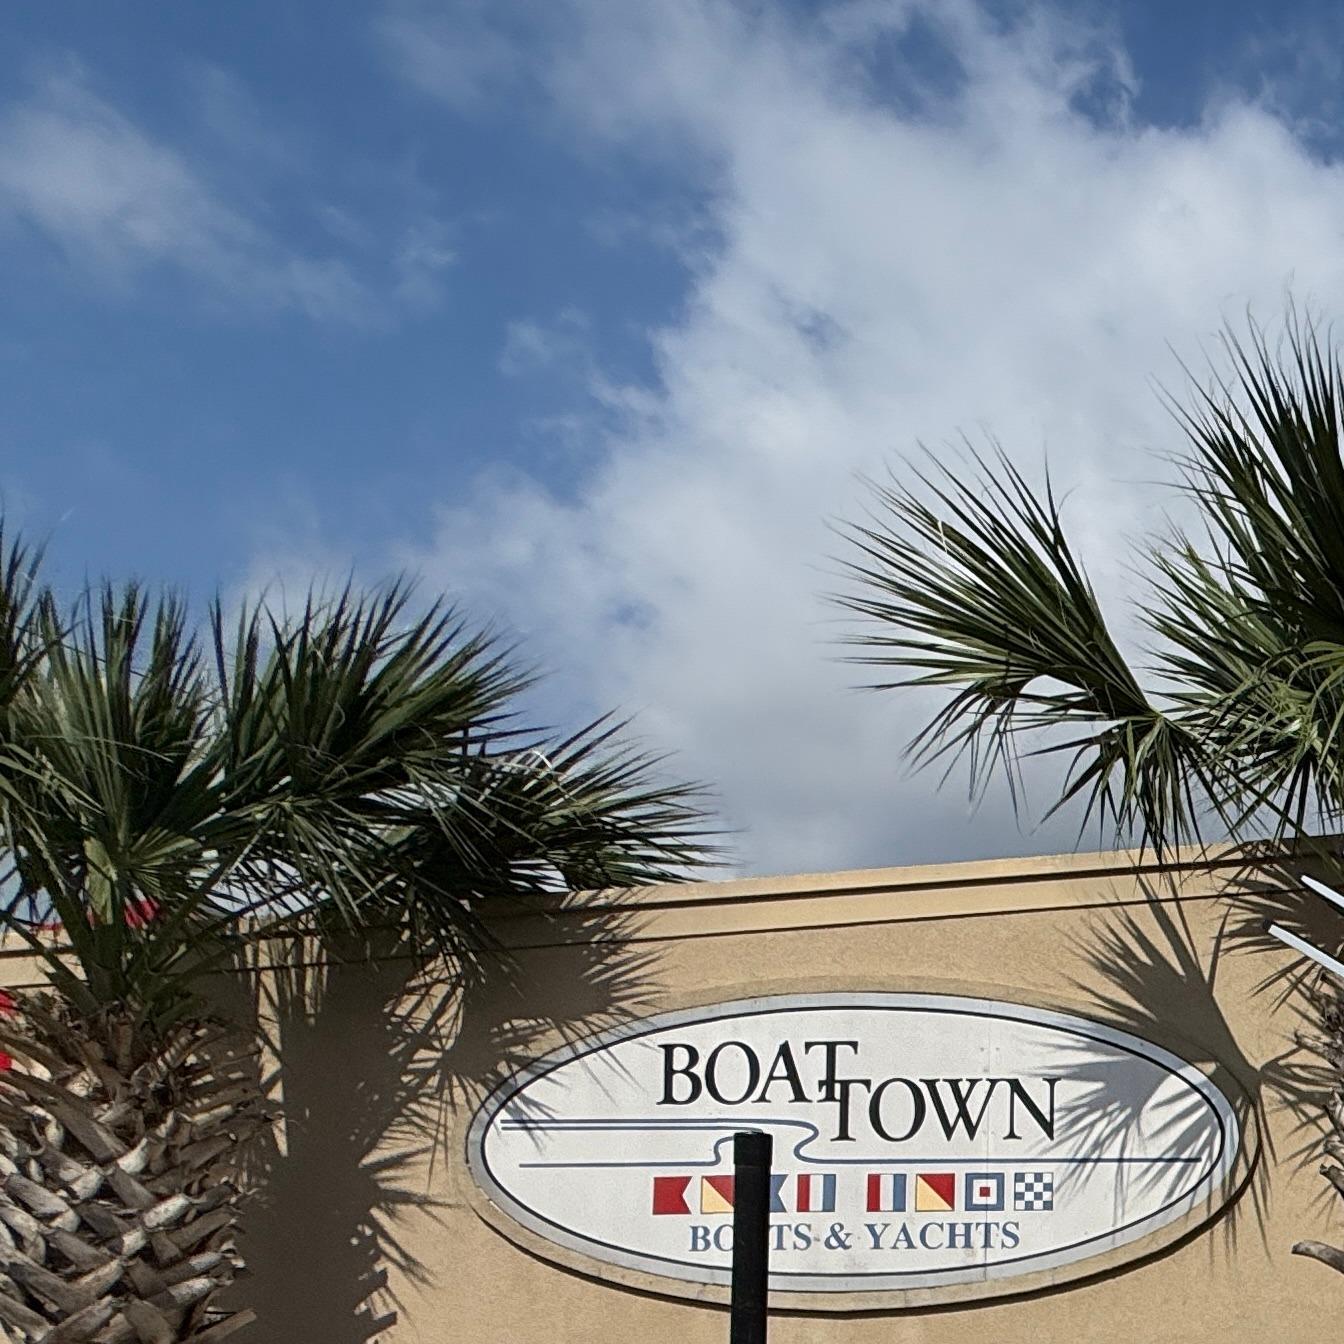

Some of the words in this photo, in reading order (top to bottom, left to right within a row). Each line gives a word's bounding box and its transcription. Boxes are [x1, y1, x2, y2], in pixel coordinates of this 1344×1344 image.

[656, 1040, 859, 1105] BOAT
[818, 1077, 1062, 1142] TOWN
[688, 1222, 812, 1252] BOTS
[823, 1222, 852, 1251] &
[864, 1221, 1020, 1250] YACHTS
